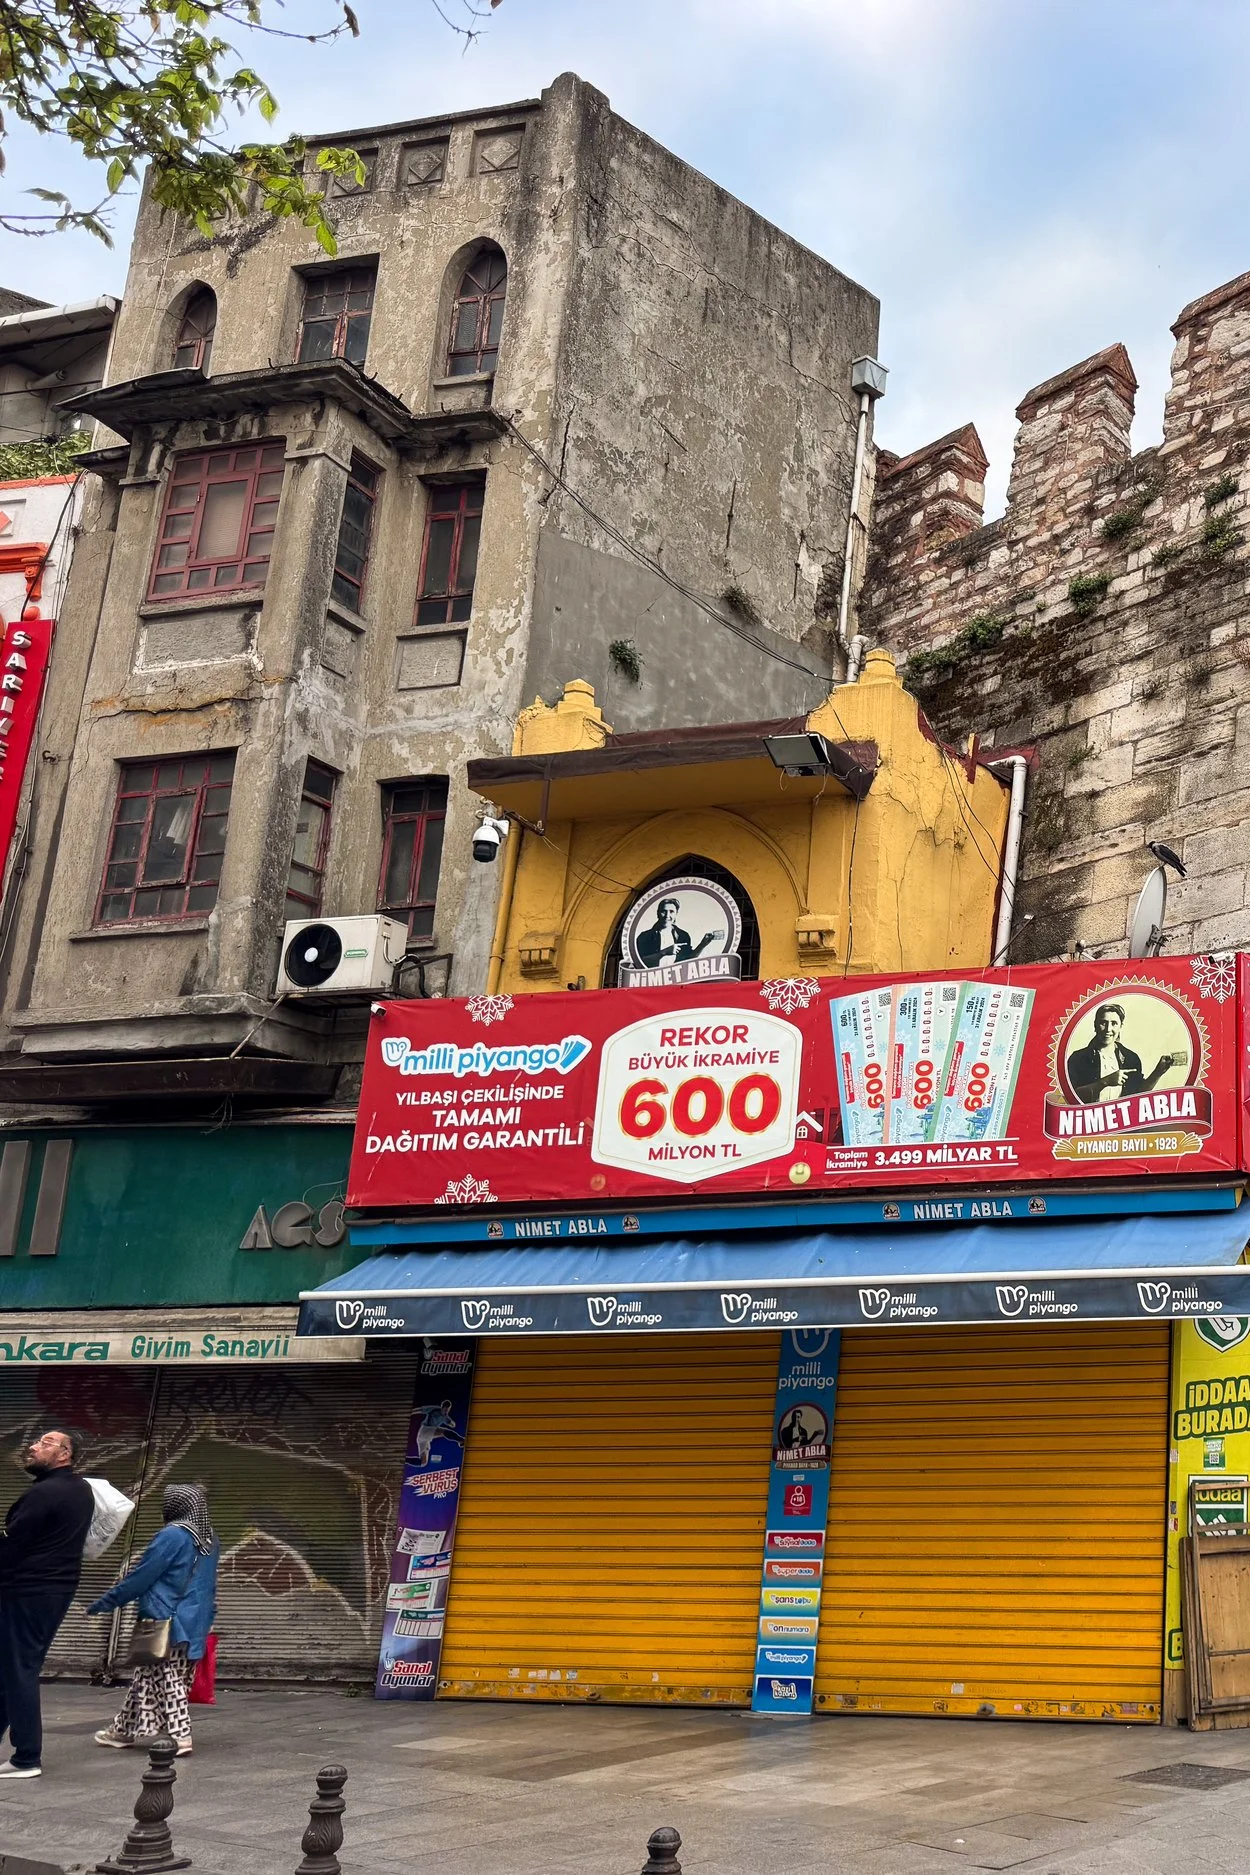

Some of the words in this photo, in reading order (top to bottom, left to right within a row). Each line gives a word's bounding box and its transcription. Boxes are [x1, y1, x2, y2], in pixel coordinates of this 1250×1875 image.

[0, 631, 31, 780] SARI
[688, 957, 730, 980] ABLA
[966, 1000, 975, 1013] 150
[660, 1025, 749, 1047] REKOR
[404, 1047, 454, 1071] milli
[457, 1045, 561, 1073] piyango
[628, 1052, 689, 1070] BÜYÜK
[693, 1047, 780, 1067] İKRAMİYE
[864, 1063, 885, 1109] 600
[913, 1060, 934, 1110] 600
[964, 1062, 990, 1112] 600
[396, 1089, 458, 1106] YILBAŞI
[462, 1083, 564, 1105] ÇEKİLİŞİNDE
[618, 1072, 782, 1140] 600
[1138, 1091, 1197, 1120] ABLA
[432, 1107, 521, 1127] TAMAMI
[366, 1130, 458, 1153] DAĞITIM
[462, 1121, 585, 1149] GARANTİLİ
[1154, 1137, 1178, 1150] 1928
[648, 1142, 716, 1160] MİLYON
[721, 1144, 742, 1157] TL
[834, 1151, 868, 1159] Toplam
[874, 1150, 923, 1166] 3.499
[926, 1144, 992, 1163] MİLYAR
[996, 1146, 1018, 1160] TL
[826, 1158, 868, 1169] İkramiye
[913, 1200, 964, 1219] NİMET
[970, 1200, 1013, 1218] ABLA
[515, 1218, 561, 1237] NİMET
[568, 1218, 607, 1235] ABLA
[891, 1293, 917, 1306] milli
[1030, 1290, 1055, 1302] milli
[1172, 1285, 1198, 1299] milli
[490, 1303, 514, 1316] milli
[617, 1300, 642, 1314] milli
[753, 1297, 777, 1310] milli
[1029, 1301, 1078, 1315] piyango
[1171, 1298, 1223, 1313] piyango
[363, 1305, 387, 1318] milli
[616, 1312, 662, 1326] piyango
[752, 1309, 798, 1324] piyango
[889, 1304, 938, 1319] piyango
[362, 1316, 405, 1330] piyango
[488, 1314, 533, 1329] piyango
[131, 1335, 191, 1360] Giyim
[201, 1334, 290, 1359] Sanayii
[432, 1350, 470, 1363] Sanal
[421, 1362, 472, 1376] Oyunlar
[791, 1362, 821, 1375] milli
[778, 1374, 834, 1390] piyango
[805, 1445, 826, 1457] ABLA
[412, 1467, 459, 1486] SERBEST
[434, 1491, 447, 1499] PRO
[393, 1661, 432, 1675] Sanal
[381, 1673, 434, 1688] Oyunlar
